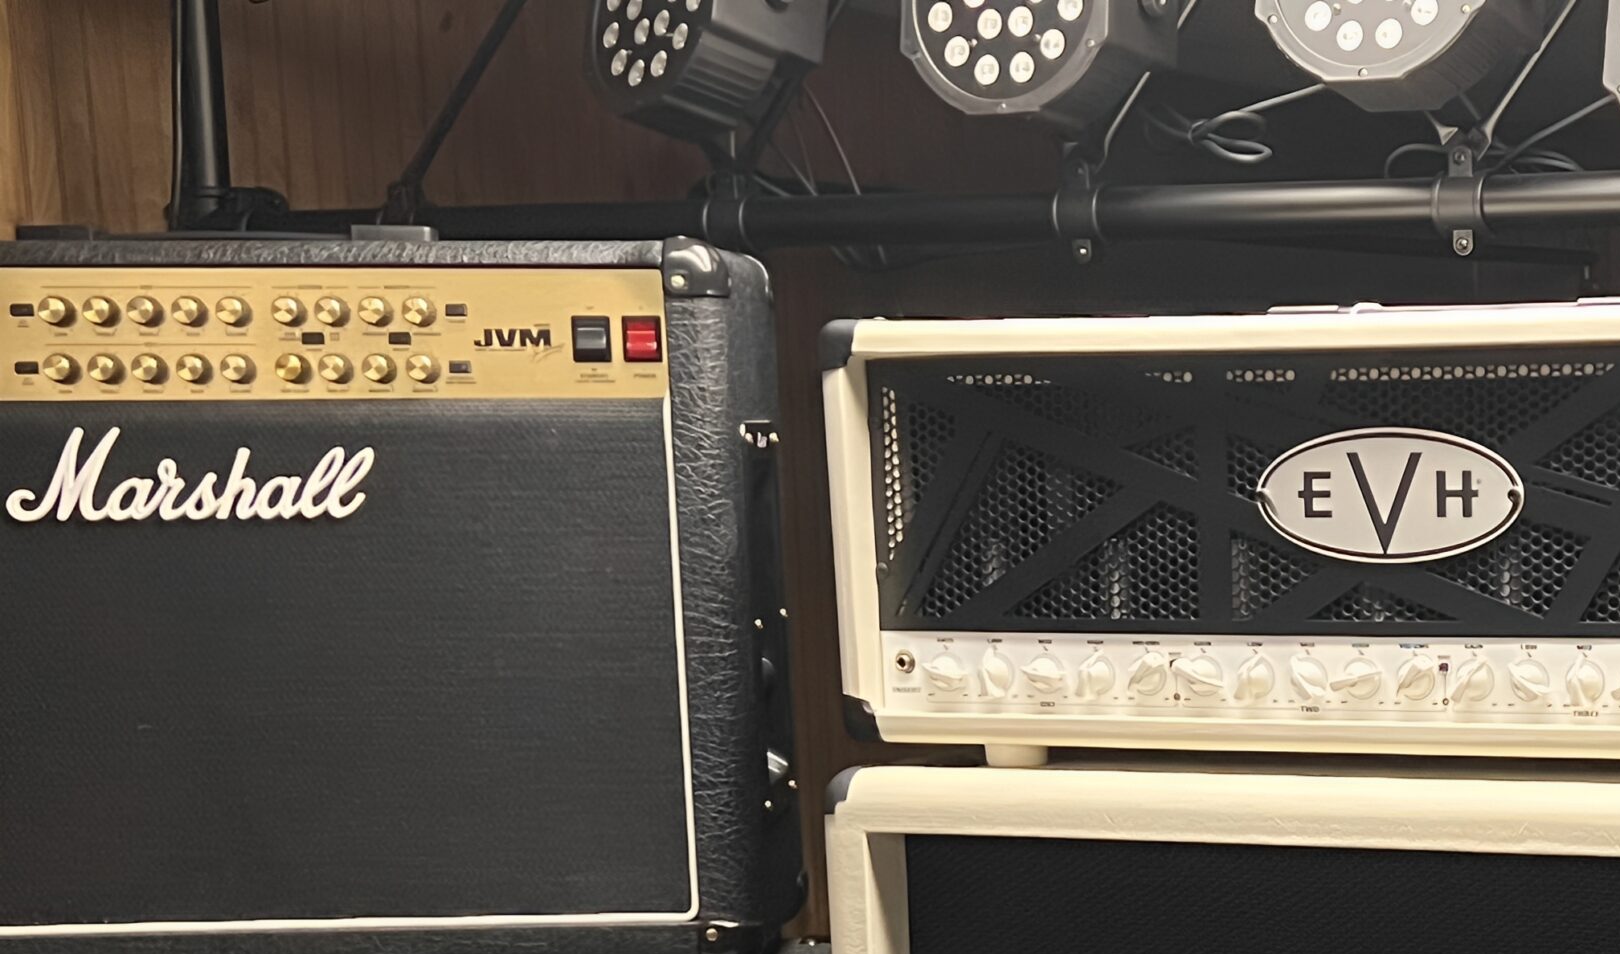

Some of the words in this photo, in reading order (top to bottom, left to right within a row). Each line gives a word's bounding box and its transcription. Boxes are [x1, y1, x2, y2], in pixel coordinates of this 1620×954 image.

[474, 328, 551, 347] JVM
[6, 426, 374, 522] Marshall
[1297, 452, 1479, 554] EVH
